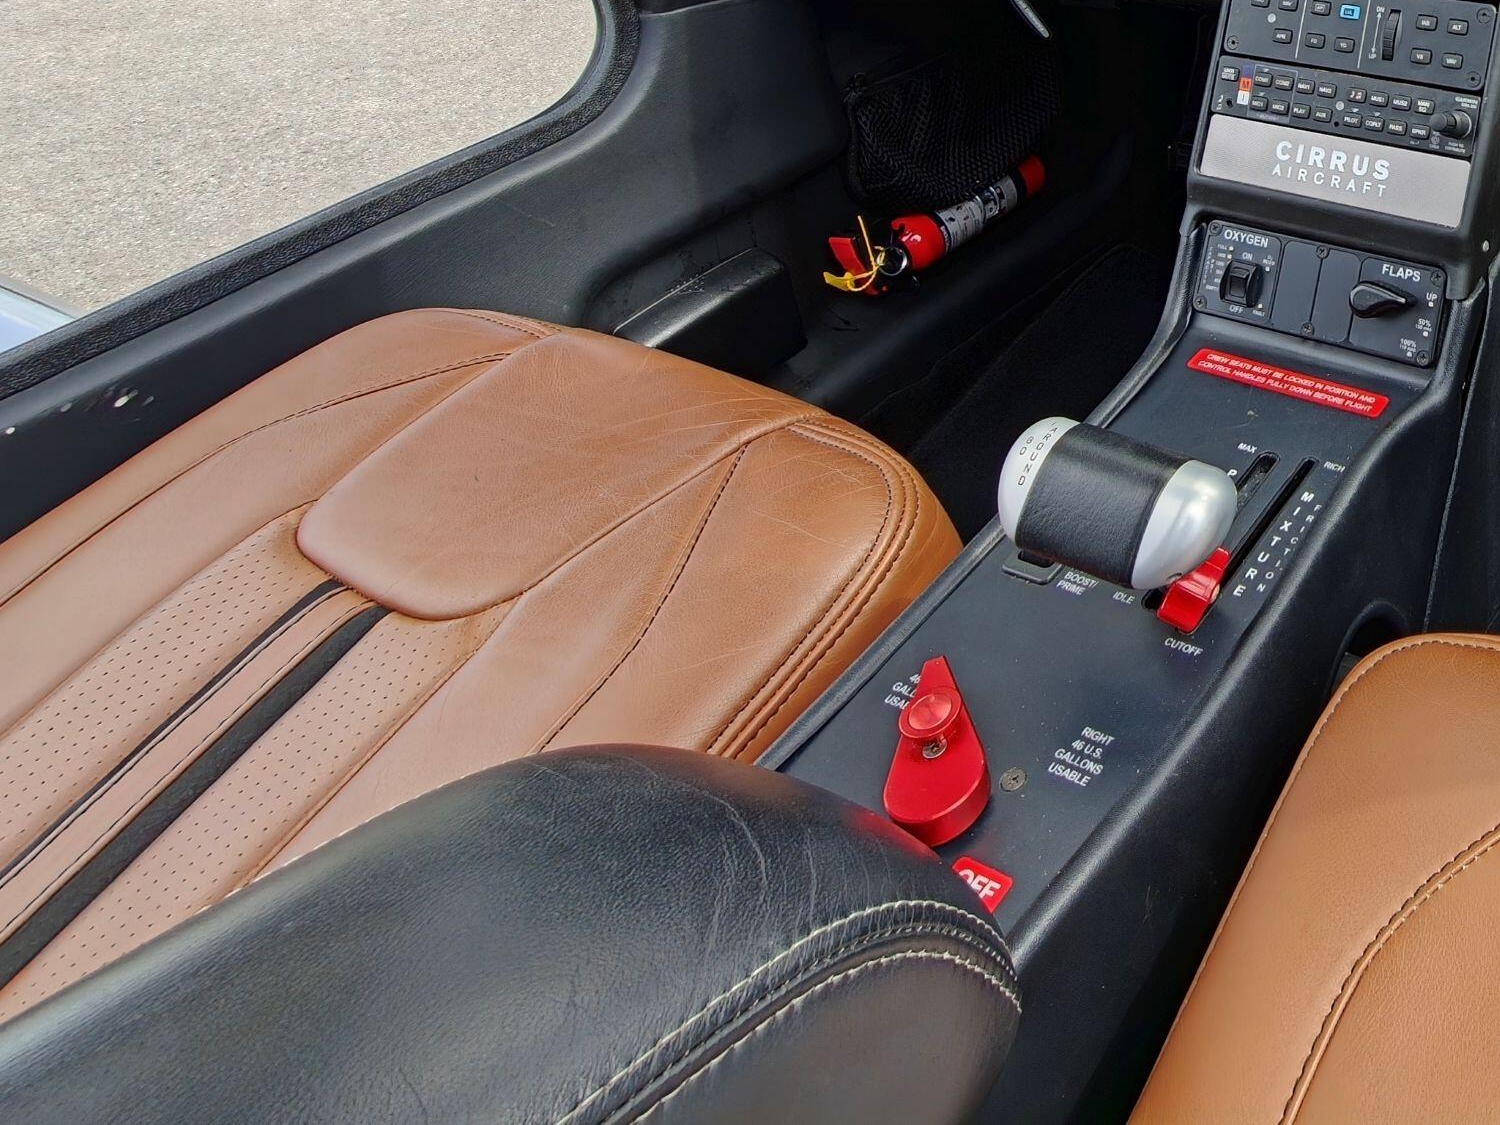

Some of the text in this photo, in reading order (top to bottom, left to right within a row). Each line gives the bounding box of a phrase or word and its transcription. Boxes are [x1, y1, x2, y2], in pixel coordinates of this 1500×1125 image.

[1344, 115, 1359, 124] PILOT
[1275, 140, 1392, 181] CIRRUS
[1272, 163, 1387, 197] AIRCRAFT
[1224, 229, 1269, 248] OXYGEN
[1242, 252, 1253, 261] ON
[1382, 263, 1421, 282] FLAPS
[1426, 292, 1437, 301] UP
[1229, 304, 1244, 314] OFF
[1418, 318, 1431, 327] 50%
[1400, 338, 1417, 348] 100%
[1198, 360, 1373, 412] CONTROL HANDLES FULLY DOWN BEFORE FLIGHT
[1206, 354, 1376, 404] CREW SEATS MUST BE LOCKED IN POSITION AND
[1237, 442, 1257, 454] MAX
[1323, 461, 1346, 473] RICH
[1233, 491, 1315, 597] MIXTURE
[1256, 504, 1322, 593] FRICTION
[1056, 580, 1086, 596] PRIME
[1064, 571, 1099, 588] BOOST/
[1112, 591, 1136, 605] IDLE
[1164, 637, 1204, 657] CUTOFF
[909, 674, 921, 684] 46
[892, 681, 917, 698] GALL
[1081, 726, 1115, 746] RIGHT
[1071, 739, 1103, 759] 46 U.S.
[1054, 748, 1103, 775] GALLONS
[1047, 761, 1091, 787] USABLE
[958, 868, 1002, 899] OFF
